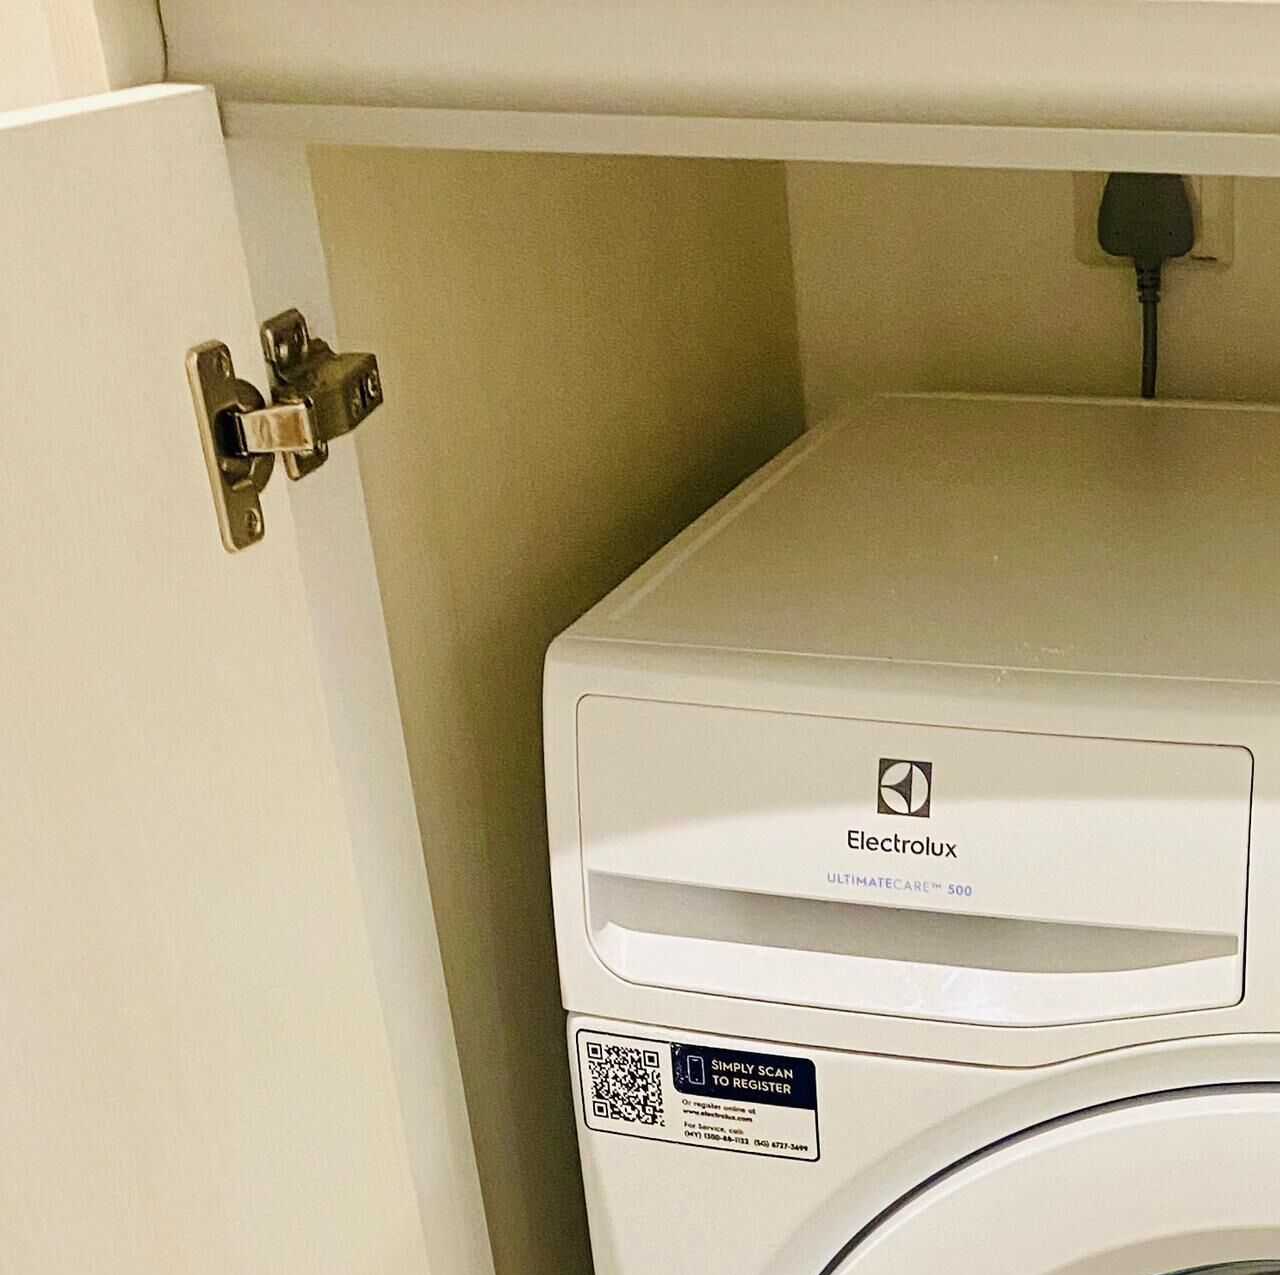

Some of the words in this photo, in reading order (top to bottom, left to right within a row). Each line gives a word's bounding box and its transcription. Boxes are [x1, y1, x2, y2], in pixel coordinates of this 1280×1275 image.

[847, 829, 958, 859] Electrolux
[947, 884, 973, 897] 500
[711, 1059, 755, 1075] SIMPLY
[758, 1065, 794, 1079] SCAN
[712, 1074, 729, 1087] TO
[733, 1078, 792, 1094] REGISTER
[683, 1108, 753, 1123] www.electrolux.com
[723, 1105, 746, 1114] online
[684, 1121, 696, 1129] For
